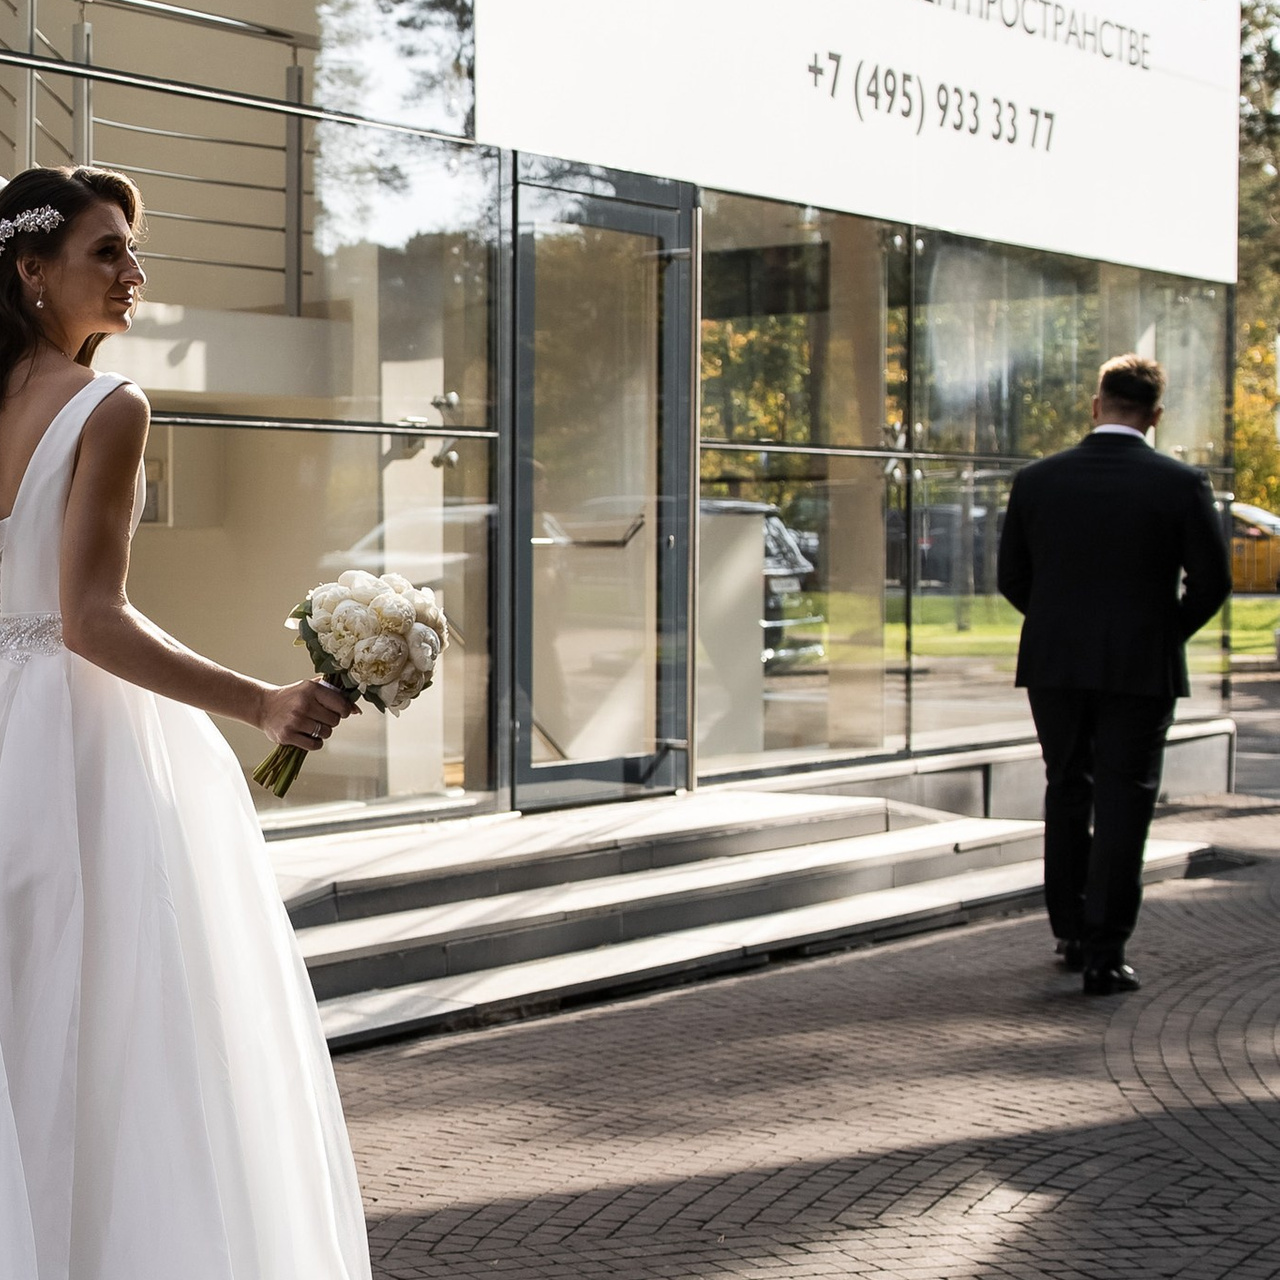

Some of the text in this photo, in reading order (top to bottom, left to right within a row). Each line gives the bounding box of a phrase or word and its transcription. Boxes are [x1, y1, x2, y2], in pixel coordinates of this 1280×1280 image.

[807, 51, 1057, 153] +7 (495) 933 33 77
